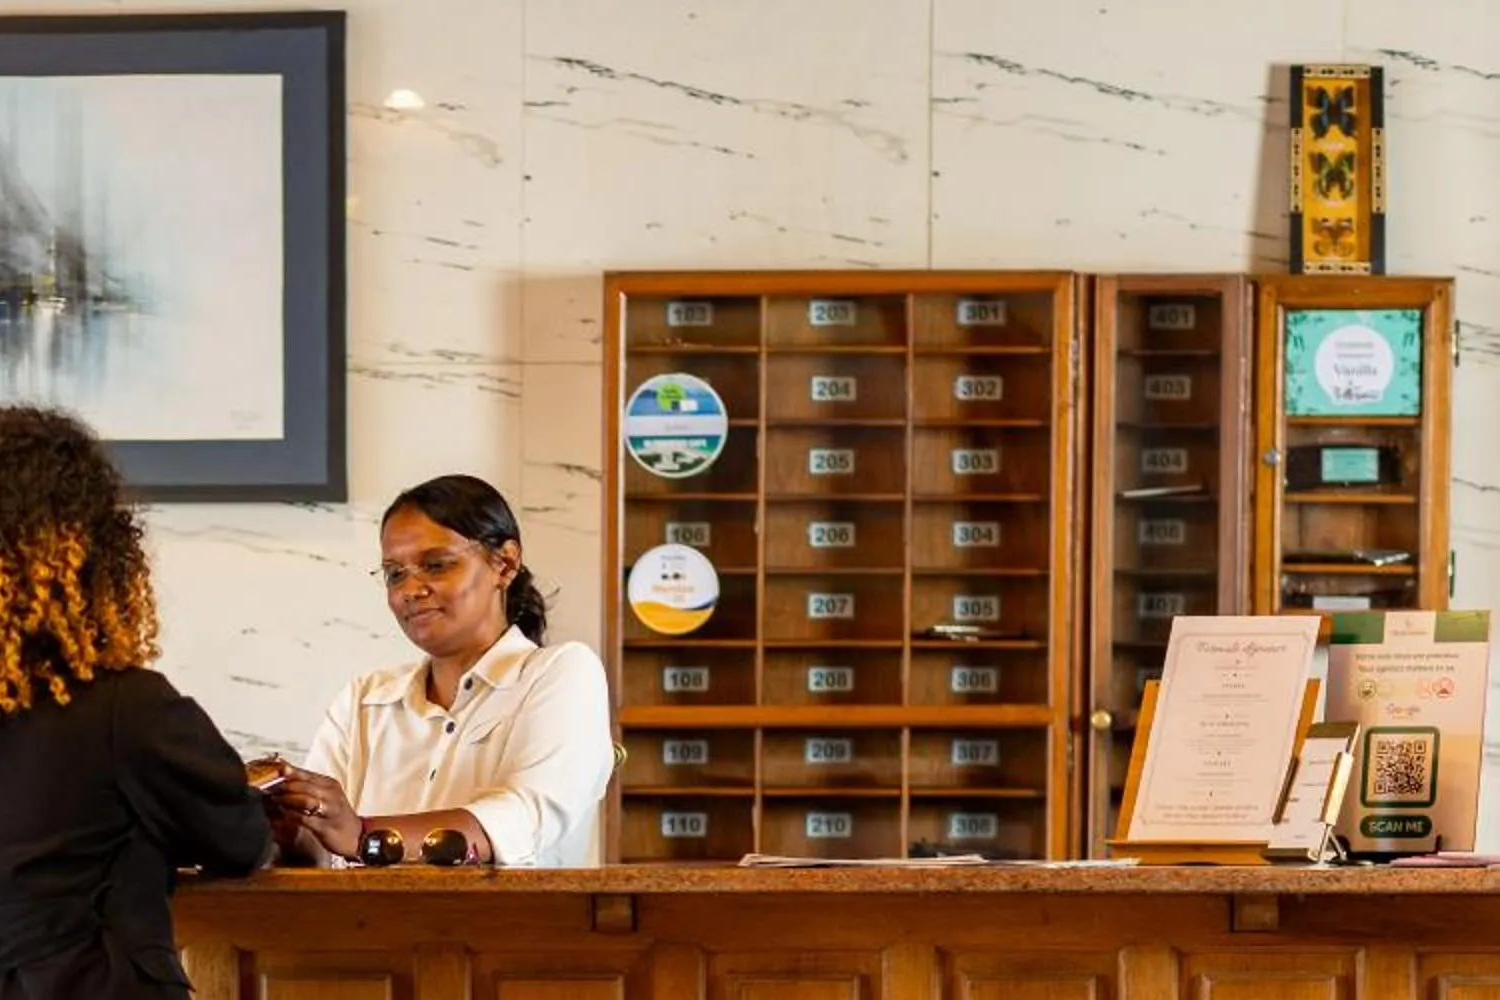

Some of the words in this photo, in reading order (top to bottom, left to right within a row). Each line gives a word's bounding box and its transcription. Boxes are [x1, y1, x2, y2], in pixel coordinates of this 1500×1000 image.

[966, 305, 998, 320] 301
[816, 381, 850, 397] 204
[962, 380, 996, 396] 302
[814, 453, 849, 469] 205
[814, 527, 849, 543] 206
[958, 527, 992, 543] 304
[813, 598, 847, 614] 207
[959, 601, 993, 617] 305
[813, 671, 847, 687] 208
[669, 744, 702, 760] 109
[812, 742, 846, 758] 209
[958, 745, 991, 760] 307
[667, 816, 700, 832] 110
[811, 816, 845, 832] 210
[1368, 821, 1403, 833] SCAN
[1406, 821, 1425, 833] ME
